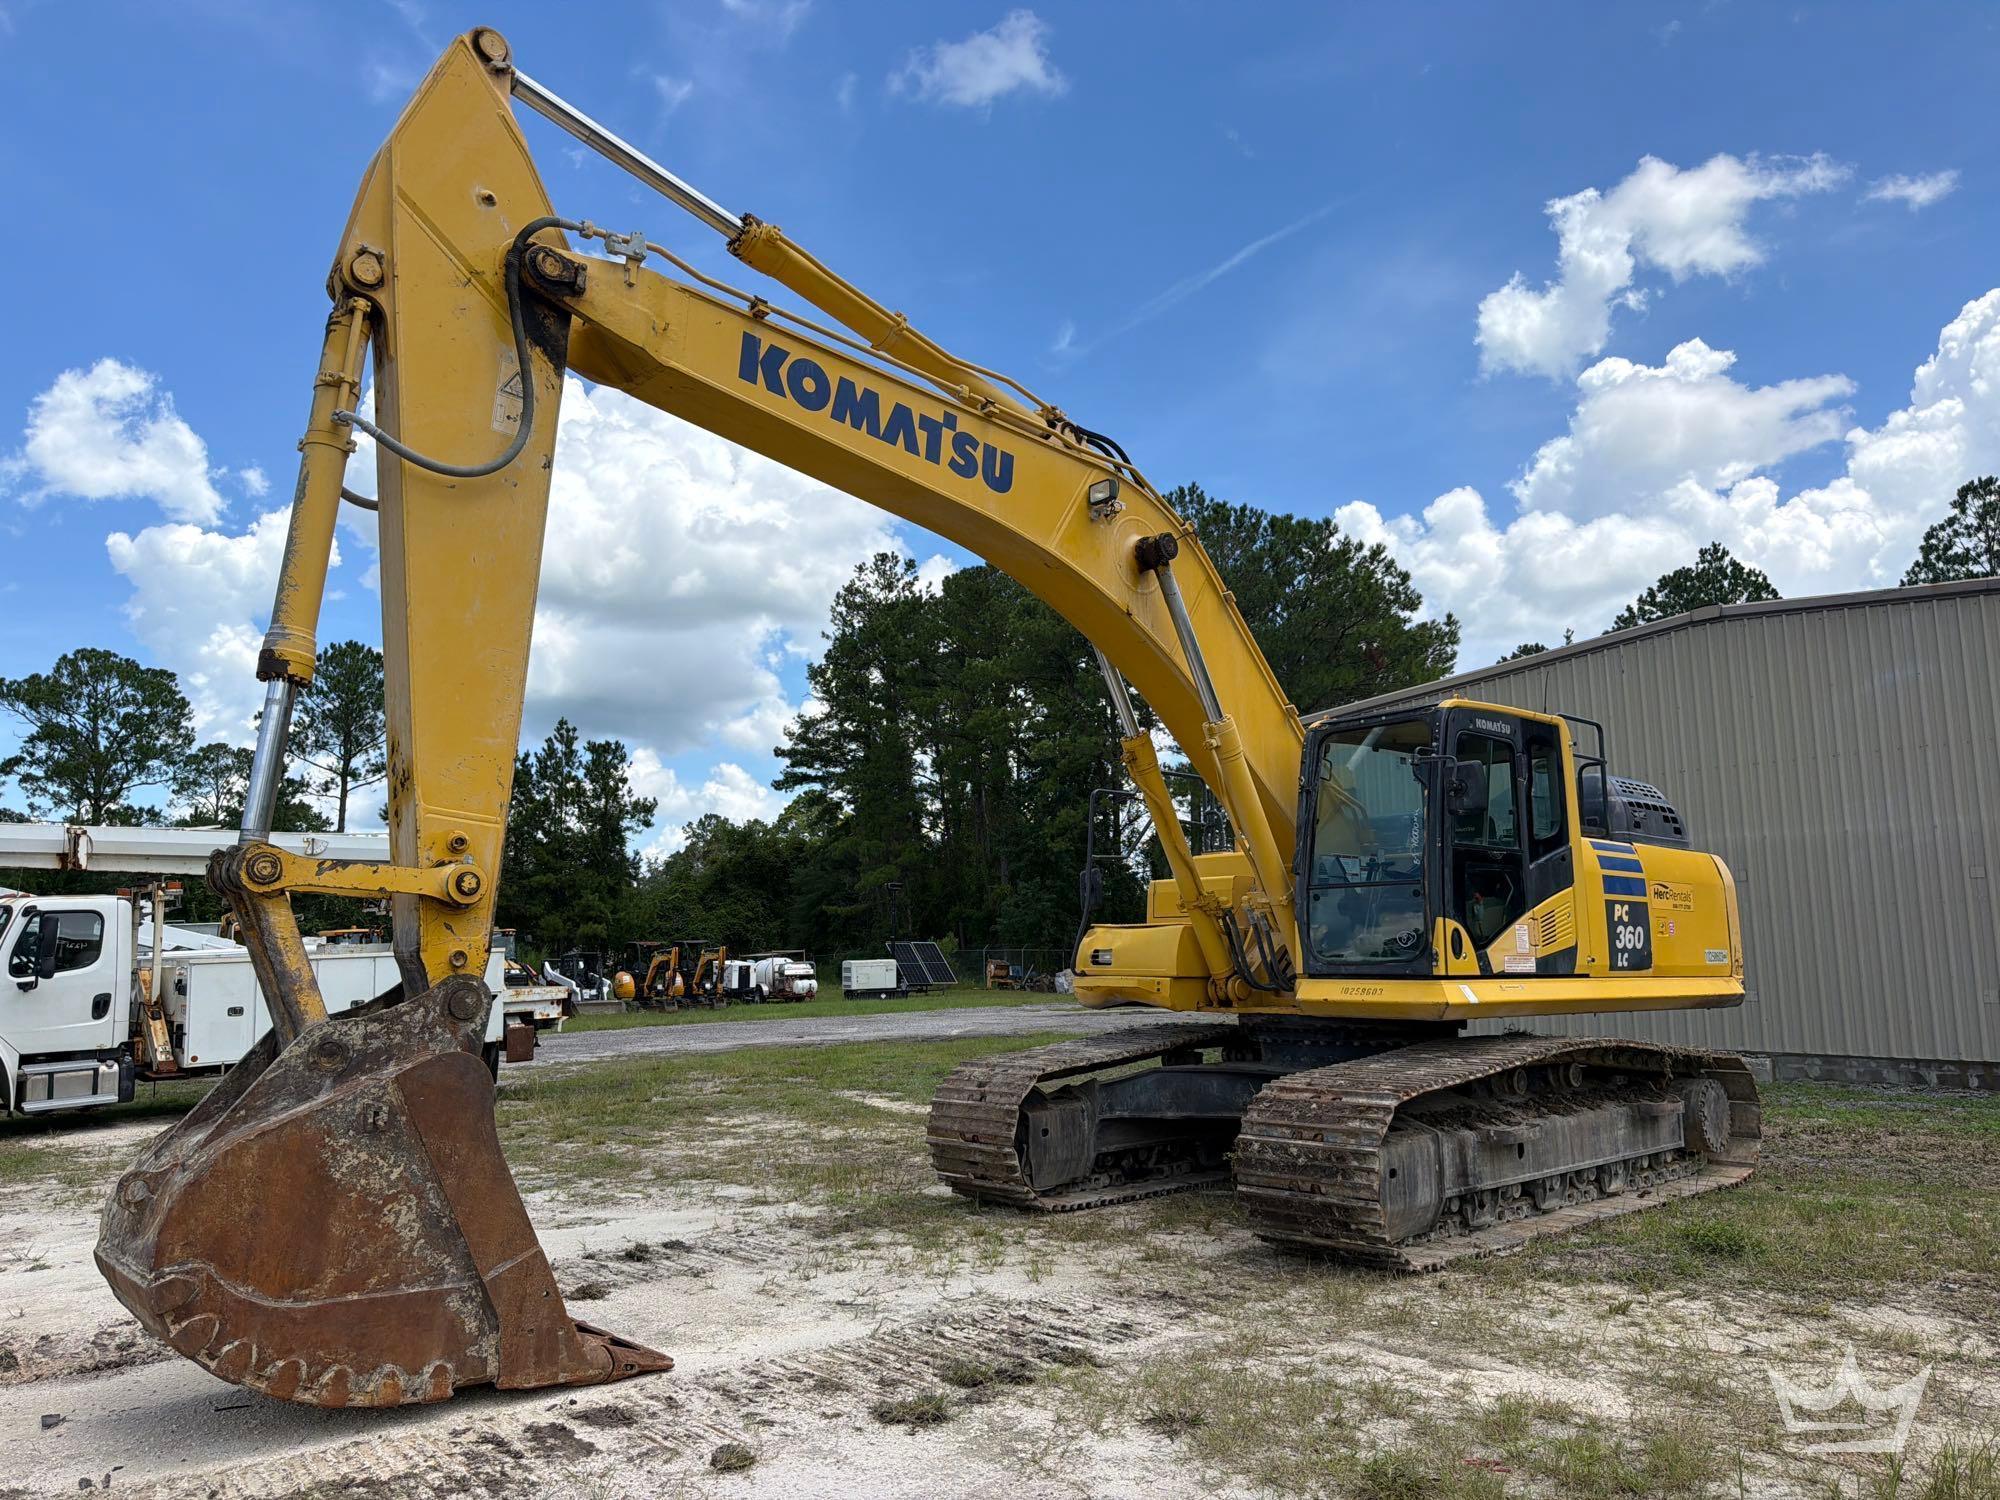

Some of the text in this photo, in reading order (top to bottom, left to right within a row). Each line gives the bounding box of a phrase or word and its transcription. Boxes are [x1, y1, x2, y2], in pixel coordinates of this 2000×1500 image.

[738, 330, 1015, 494] KOMATSU
[1475, 717, 1511, 735] KOMATSU
[1653, 887, 1692, 903] HercRentals
[1614, 903, 1629, 922] PC
[1615, 925, 1644, 950] 360
[1617, 952, 1629, 967] LC
